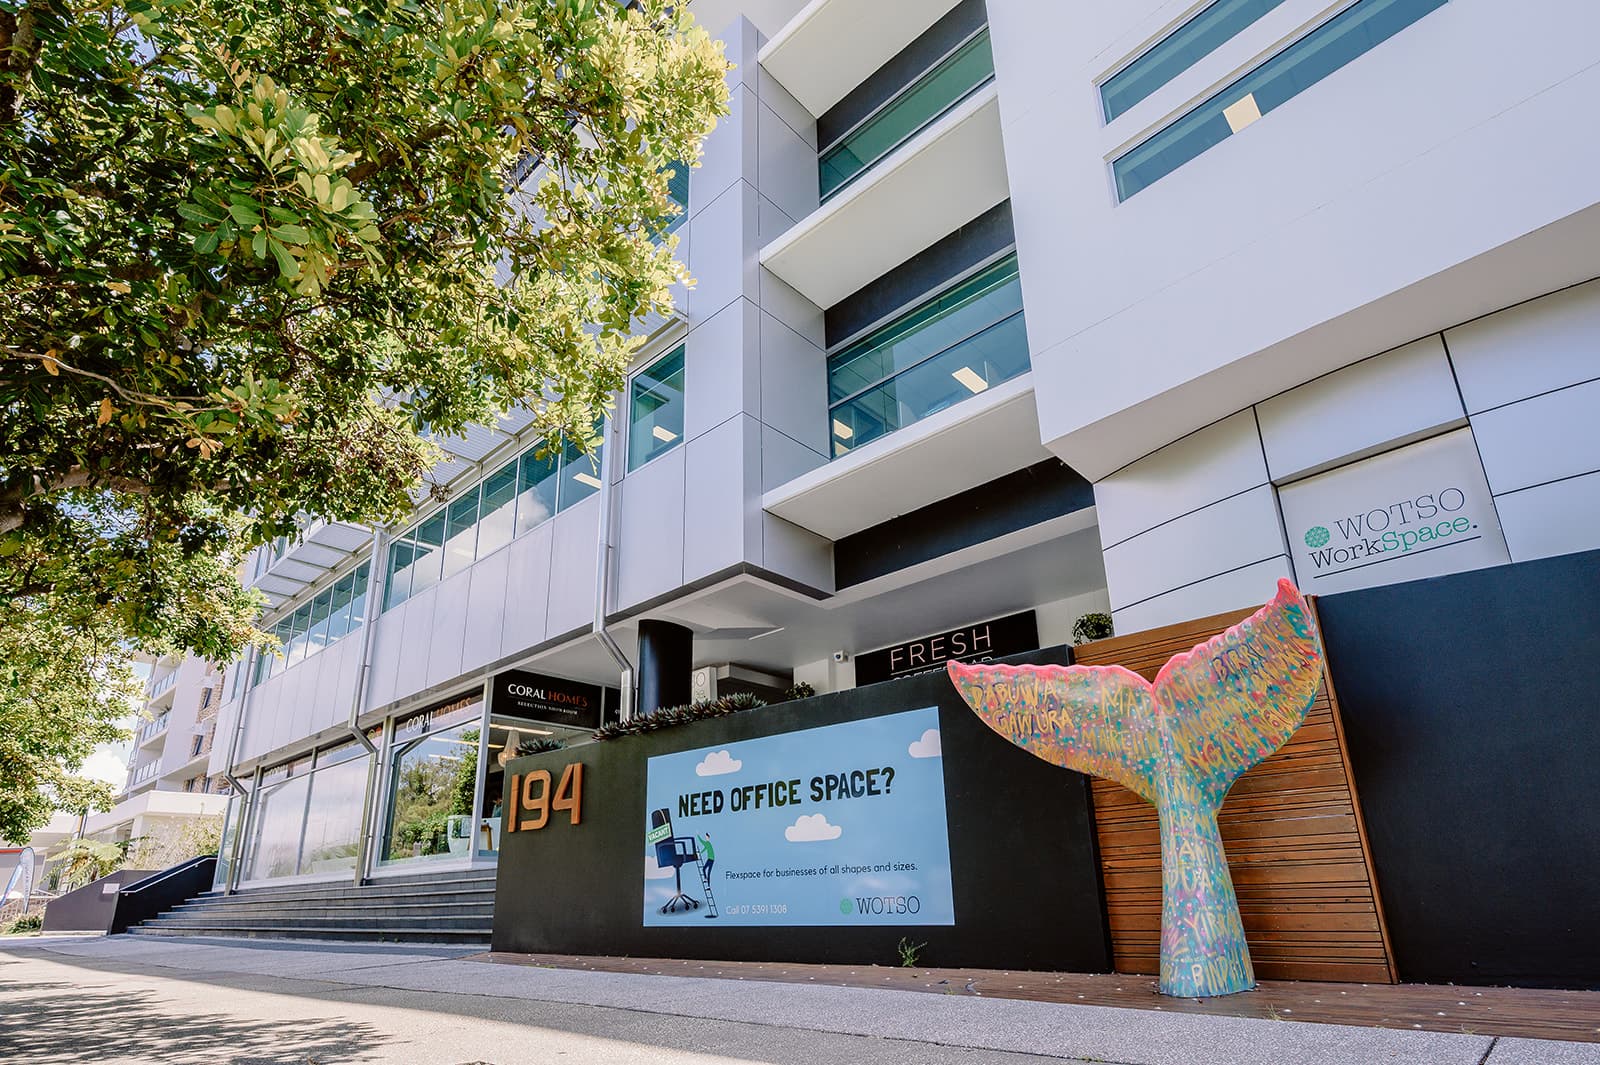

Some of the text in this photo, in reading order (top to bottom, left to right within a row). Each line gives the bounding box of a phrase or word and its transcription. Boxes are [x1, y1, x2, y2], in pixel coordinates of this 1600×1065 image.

[1334, 487, 1465, 541] WOTSO
[1309, 516, 1478, 570] WorkSpace.
[890, 625, 991, 671] FRESH
[508, 683, 588, 708] CORAL HOMES
[406, 711, 433, 733] CORAL
[507, 761, 584, 833] 194
[678, 766, 896, 818] NEED OFFICE SPACE?
[725, 861, 919, 881] Flexspace for businesses of all shapes and sizes.
[725, 904, 740, 915] Call
[741, 904, 751, 914] 07
[855, 895, 921, 915] WOTSO
